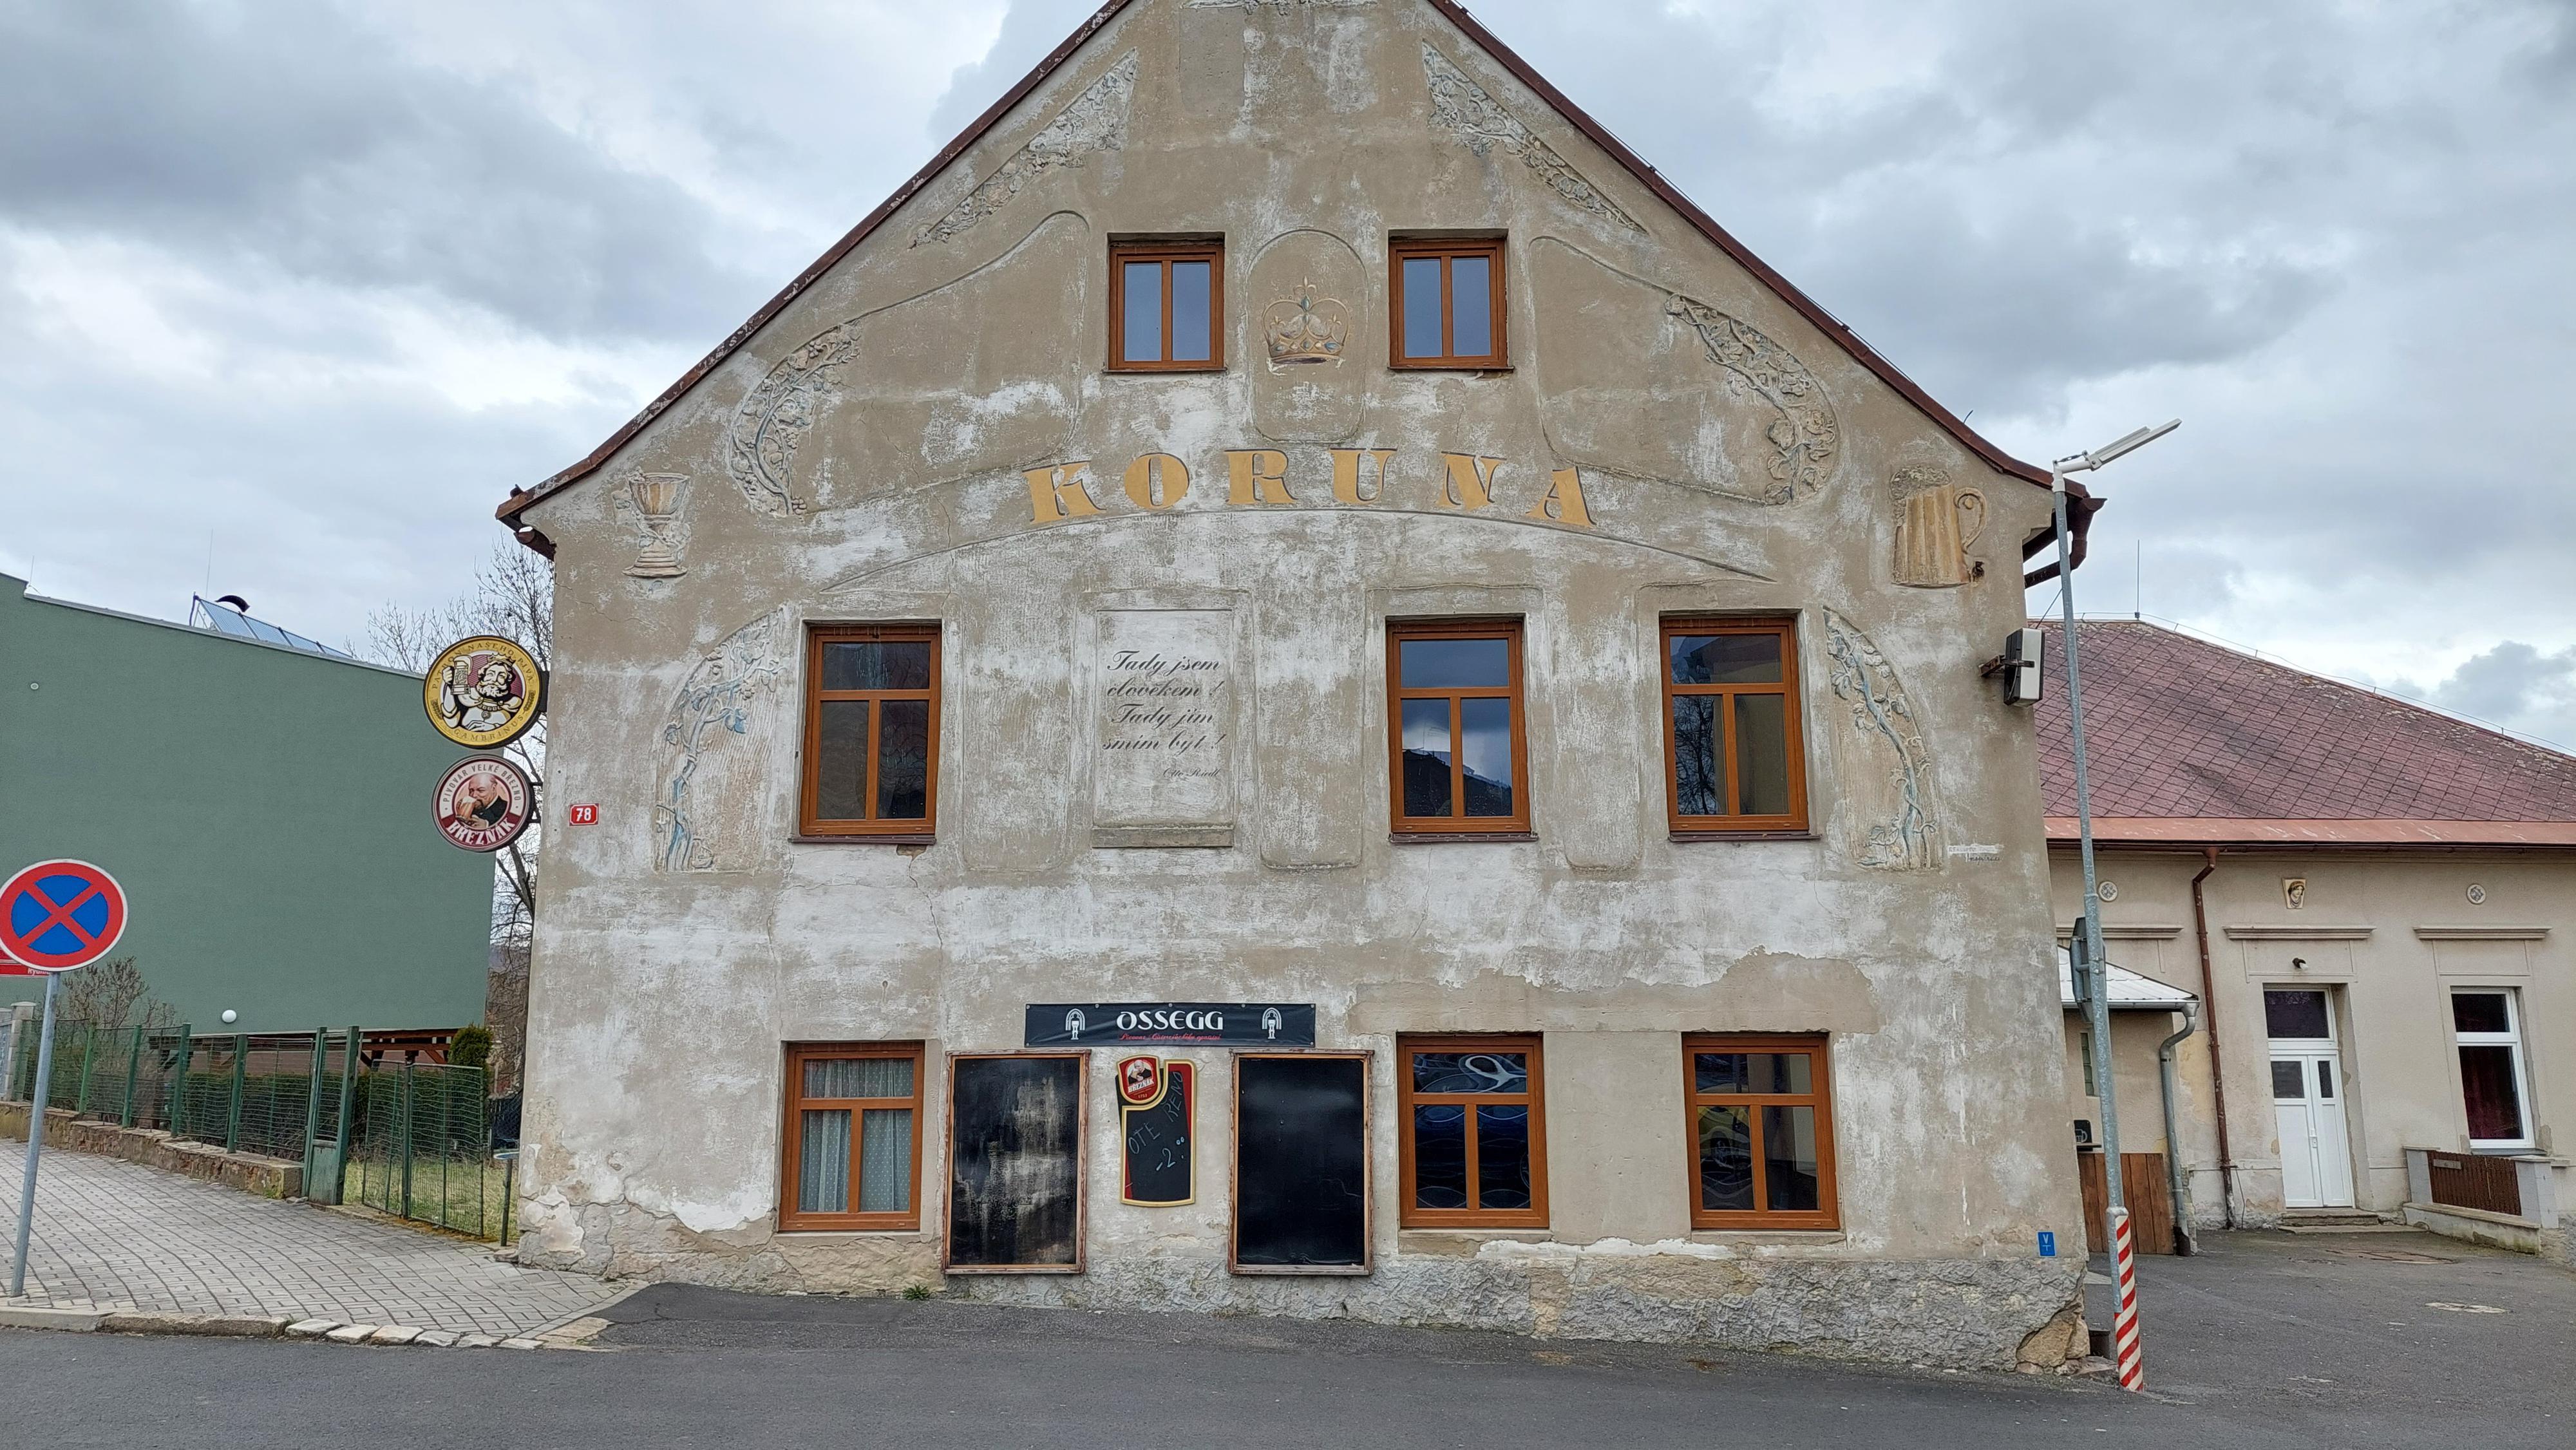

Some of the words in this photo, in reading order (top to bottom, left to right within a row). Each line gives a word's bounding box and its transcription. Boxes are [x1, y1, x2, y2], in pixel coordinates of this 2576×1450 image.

[1021, 447, 1597, 527] KORUNA
[432, 649, 462, 690] PATRON
[516, 657, 534, 681] PIVA
[1107, 650, 1167, 676] Tady
[1163, 656, 1220, 676] jsem
[454, 715, 524, 742] GAMBRINUS
[1111, 703, 1172, 730] Tady
[443, 769, 468, 802] PIVOVAR
[471, 764, 500, 773] VELKÉ
[501, 770, 521, 801] BŘEZNO
[576, 807, 592, 822] 78
[1116, 1010, 1224, 1030] OSSEGG
